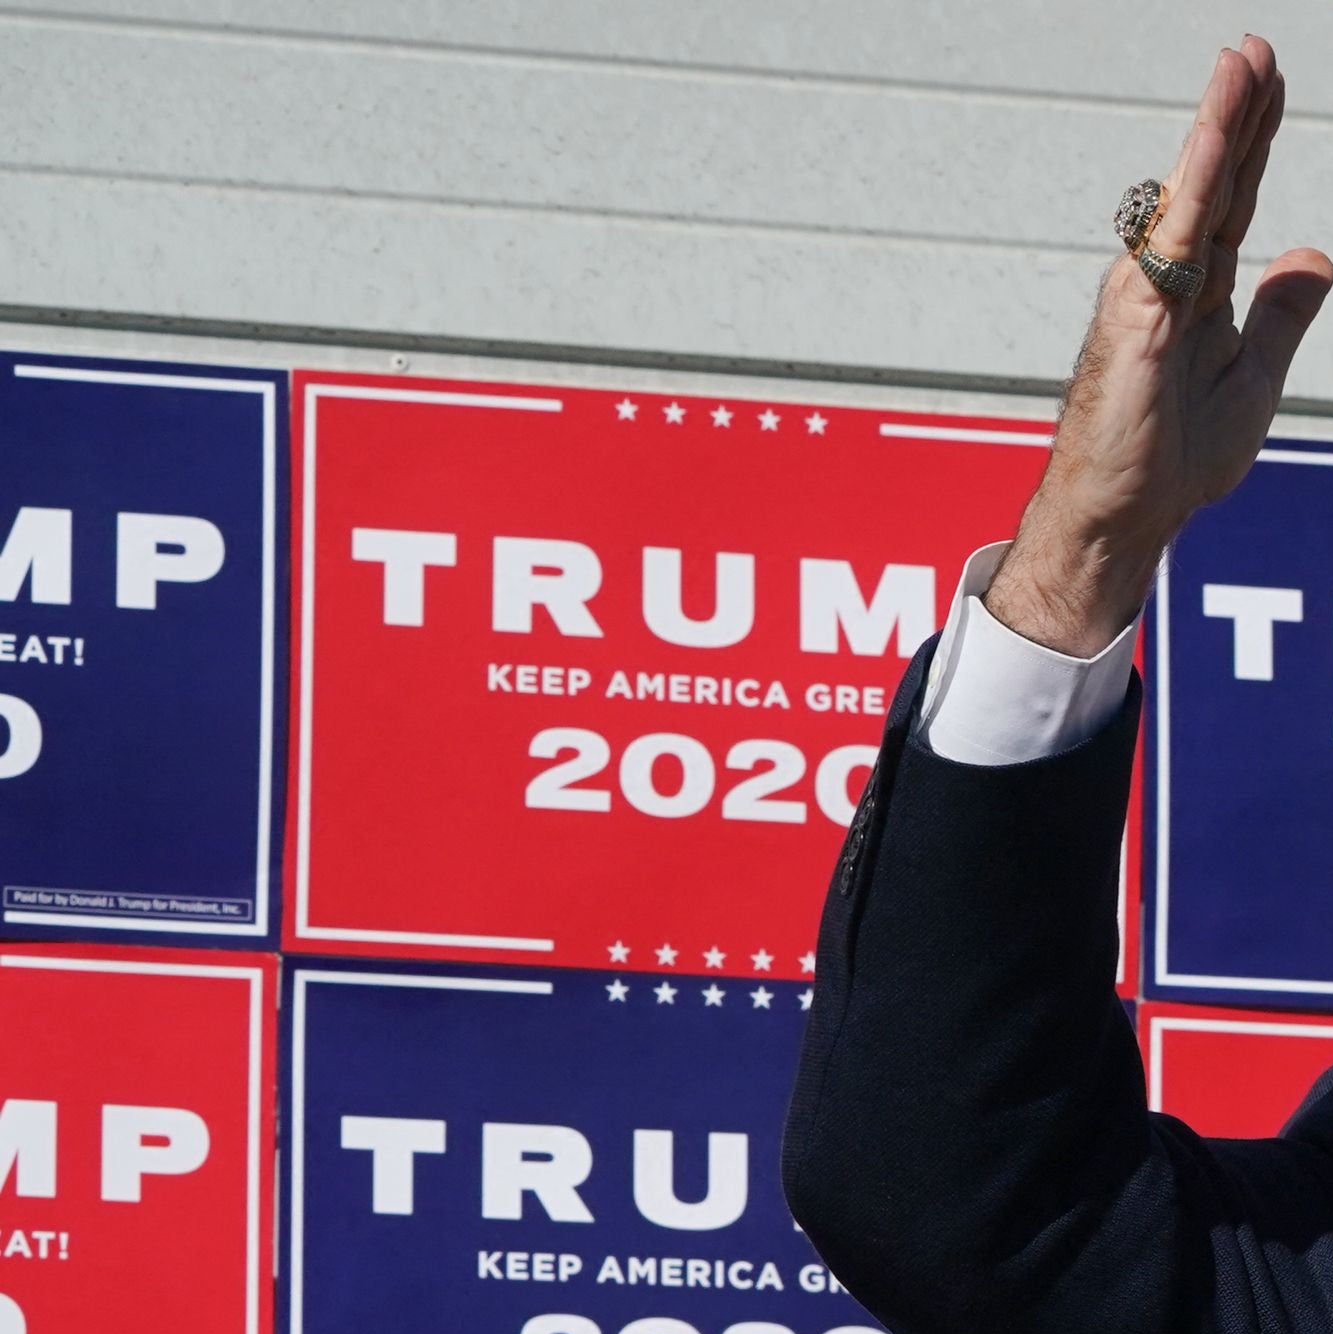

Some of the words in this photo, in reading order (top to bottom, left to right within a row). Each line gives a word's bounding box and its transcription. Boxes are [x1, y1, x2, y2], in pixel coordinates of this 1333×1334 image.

[351, 528, 936, 658] TRUM
[0, 632, 84, 666] EAT!
[488, 663, 591, 696] KEEP
[605, 670, 790, 709] AMERICA
[805, 683, 885, 715] GRE
[14, 890, 36, 904] Paid
[69, 893, 108, 908] Donald
[119, 896, 151, 911] Trump
[170, 898, 220, 914] President,
[222, 902, 242, 914] Inc.
[340, 1115, 749, 1231] TRU
[0, 1229, 69, 1260] AT!
[478, 1250, 583, 1282] KEEP
[596, 1255, 784, 1291] AMERICA
